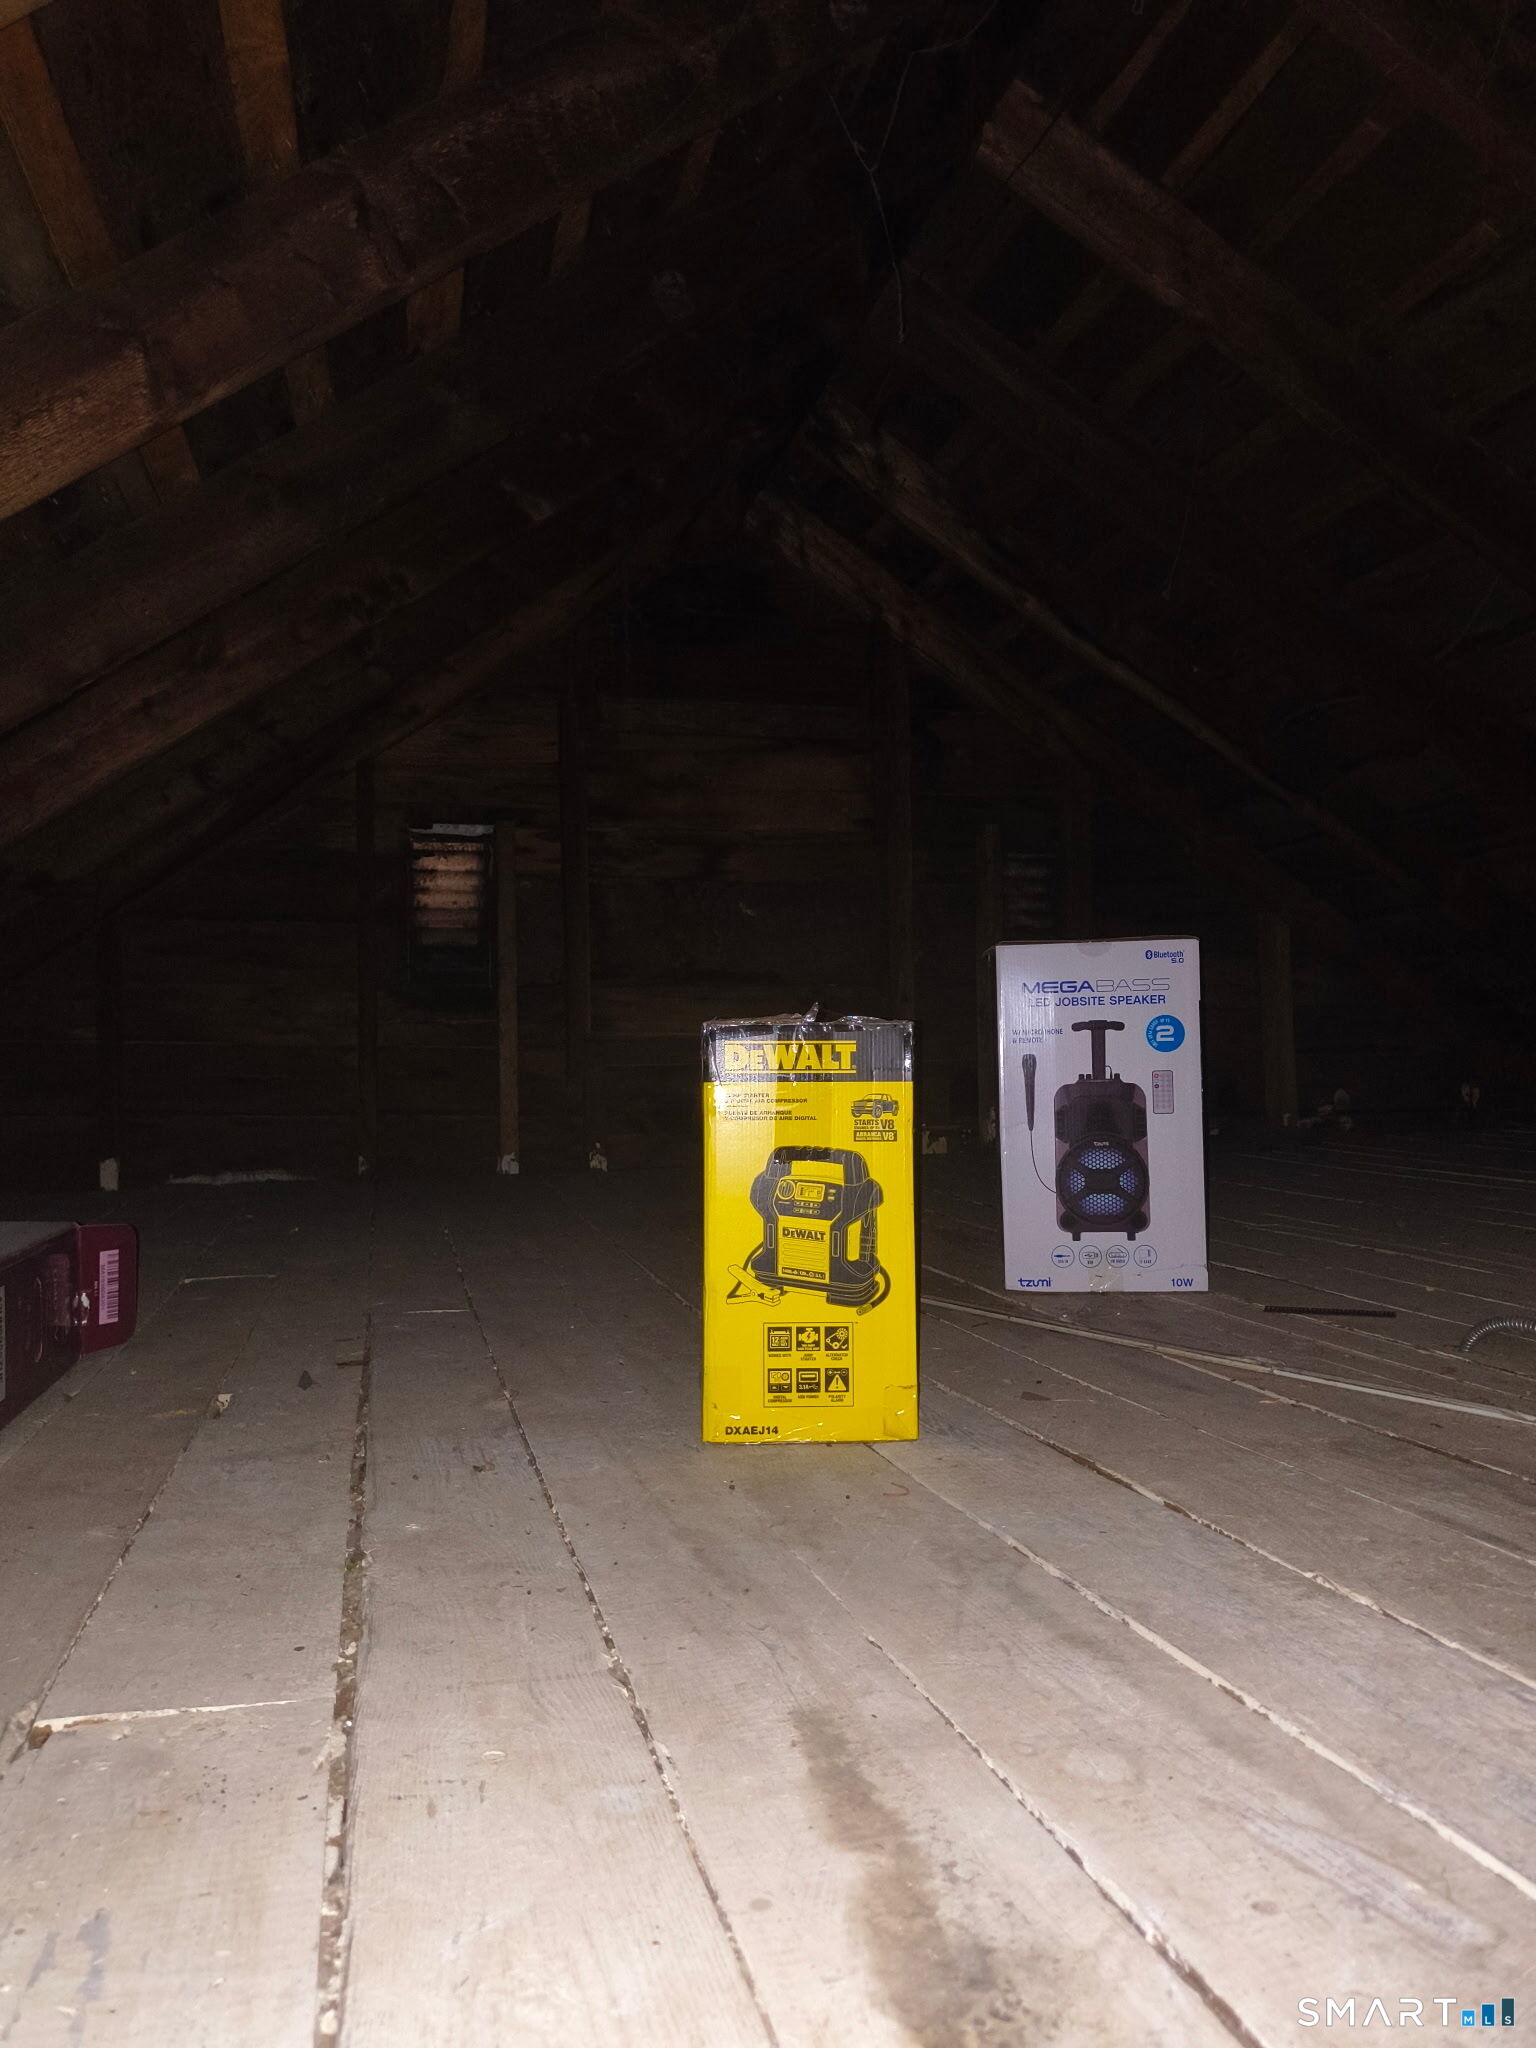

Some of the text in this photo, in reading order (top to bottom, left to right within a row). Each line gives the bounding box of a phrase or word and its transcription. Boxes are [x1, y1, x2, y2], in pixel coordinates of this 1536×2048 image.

[1153, 950, 1184, 959] Bluetooth
[1022, 977, 1170, 994] MEGABASS
[1055, 996, 1105, 1007] JOBSITE
[1109, 994, 1166, 1006] SPEAKER
[1156, 1025, 1175, 1042] 2
[880, 1119, 895, 1129] V8
[882, 1132, 894, 1140] V8
[1017, 1277, 1052, 1288] tzumi
[1170, 1277, 1194, 1287] 10W
[725, 1426, 779, 1436] DXAEJ14
